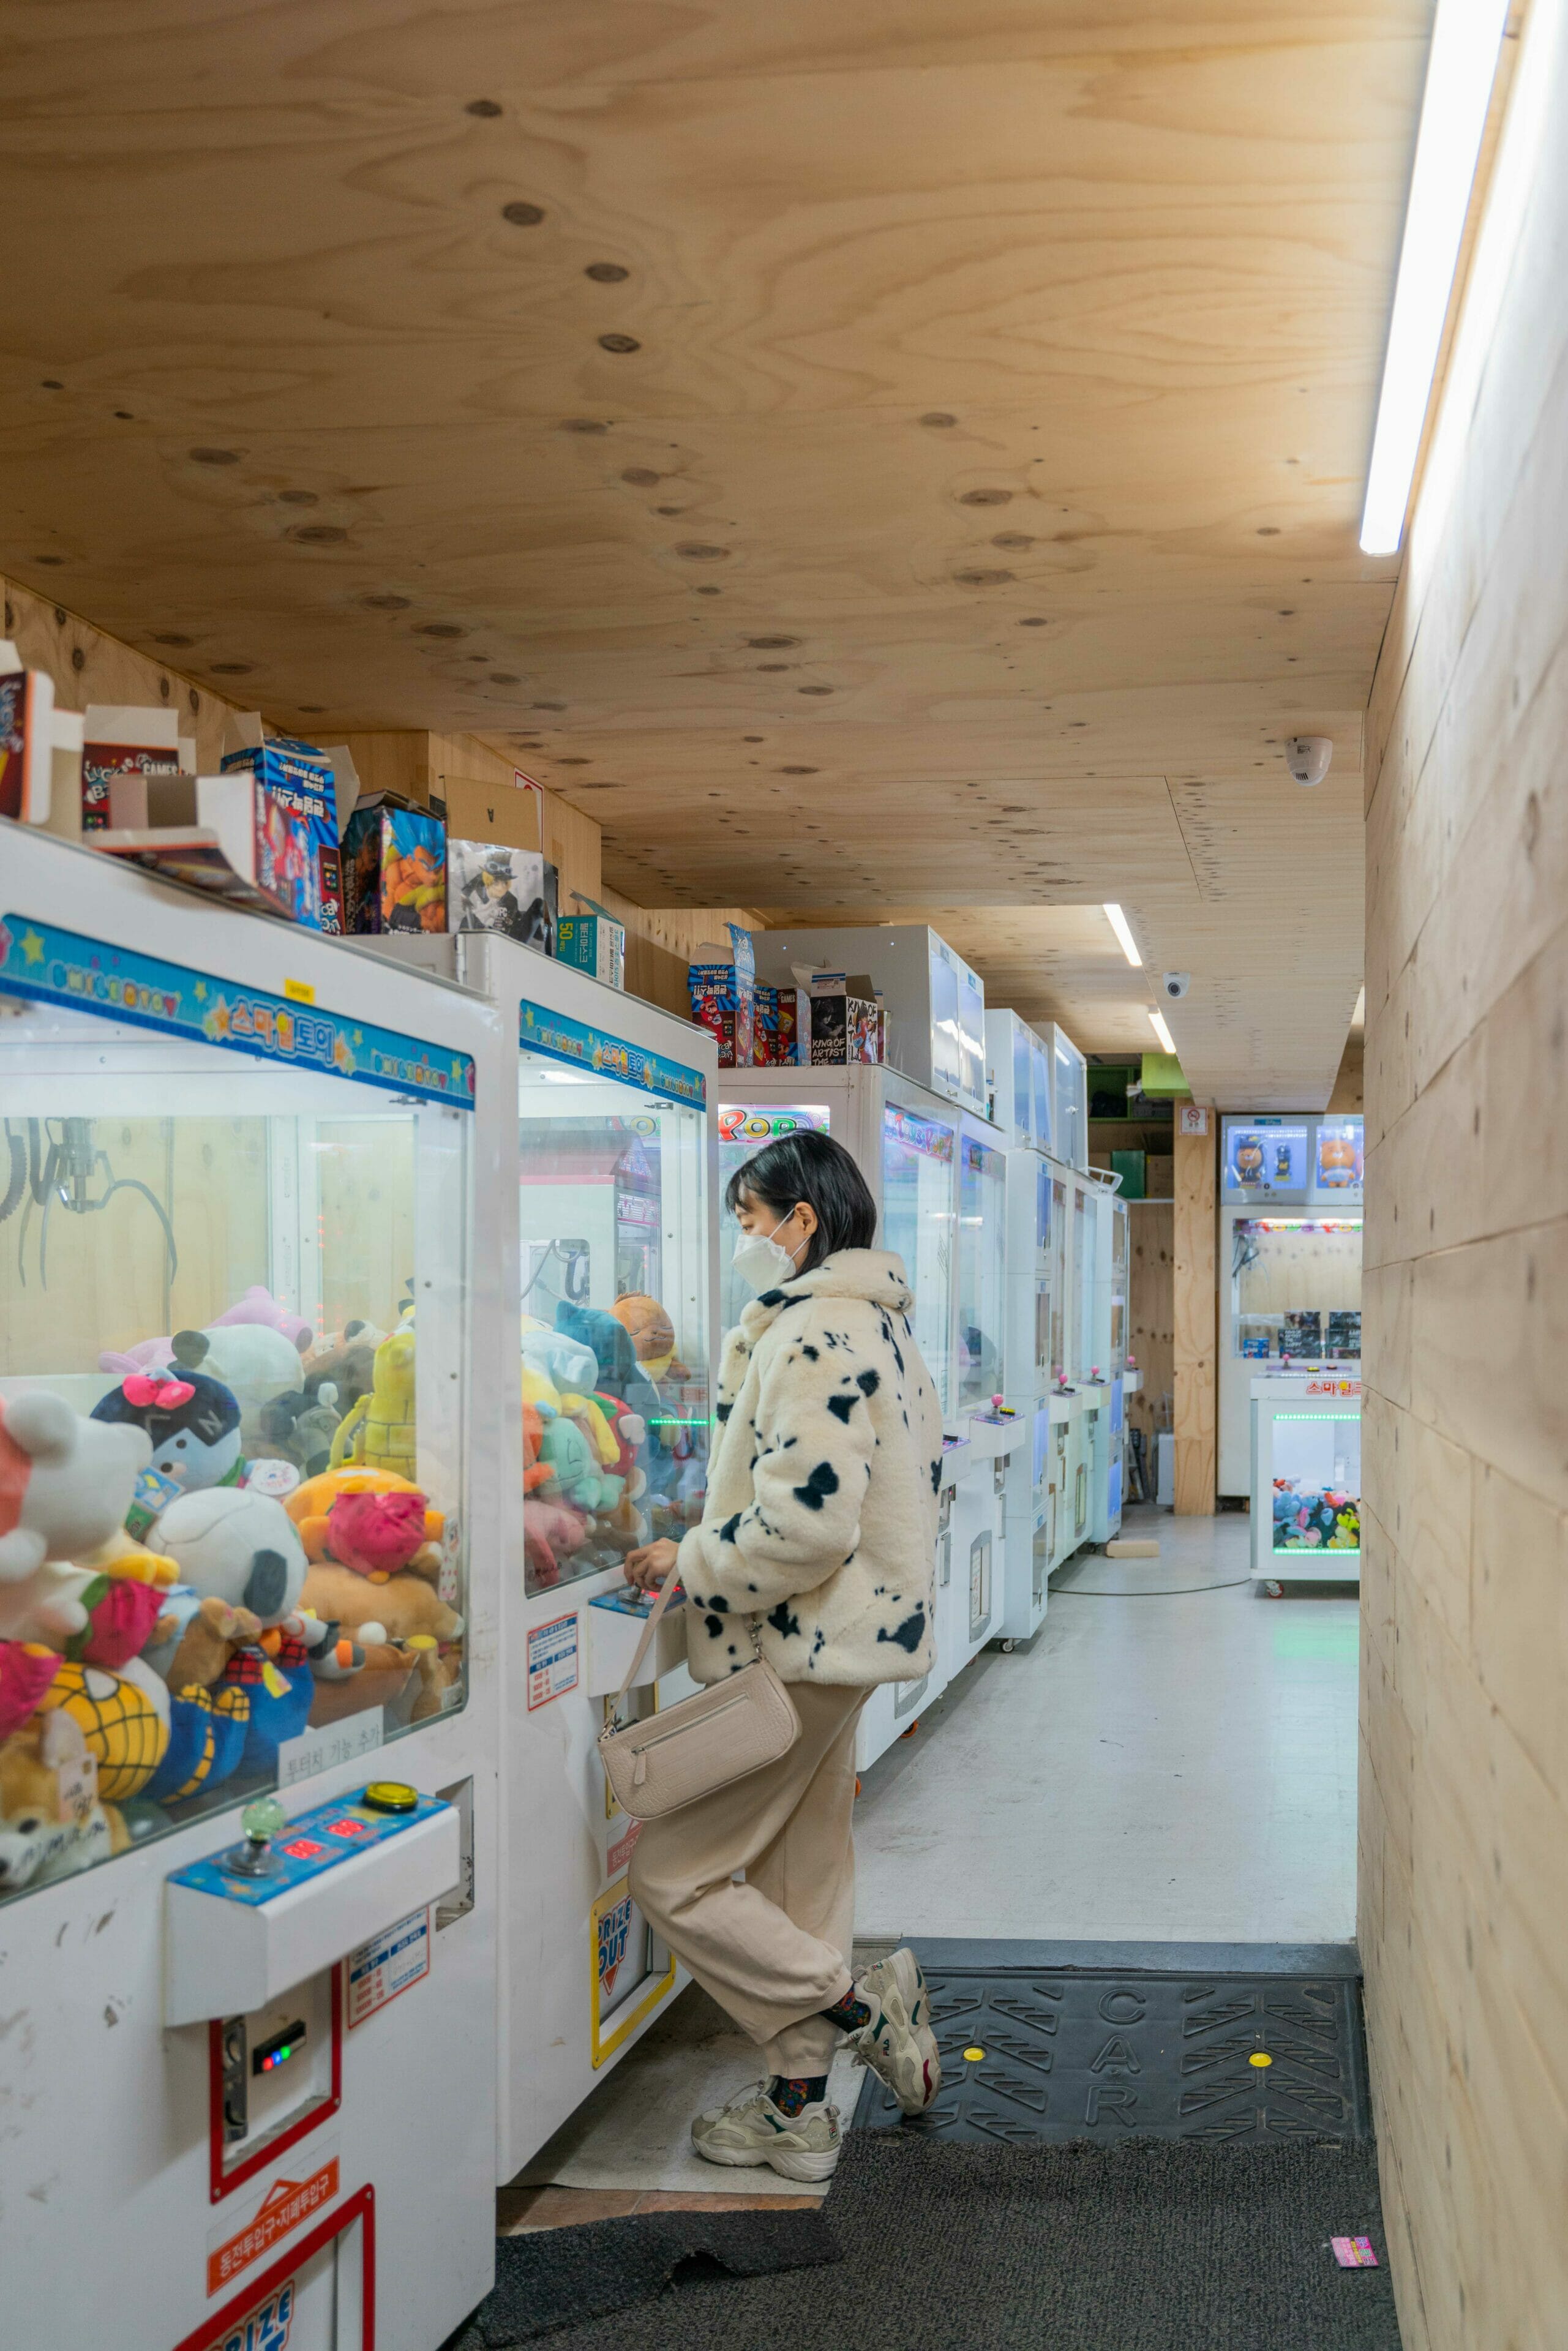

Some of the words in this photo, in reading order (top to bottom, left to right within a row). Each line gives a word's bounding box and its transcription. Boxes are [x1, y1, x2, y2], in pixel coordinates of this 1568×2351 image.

[230, 1000, 336, 1067] 스마일토이
[812, 1038, 833, 1048] KING
[833, 1037, 846, 1048] OF
[812, 1048, 846, 1058] ARTIST
[602, 1041, 645, 1084] 스마일토이
[599, 1925, 628, 1978] OUT
[1084, 1987, 1147, 2128] CAR
